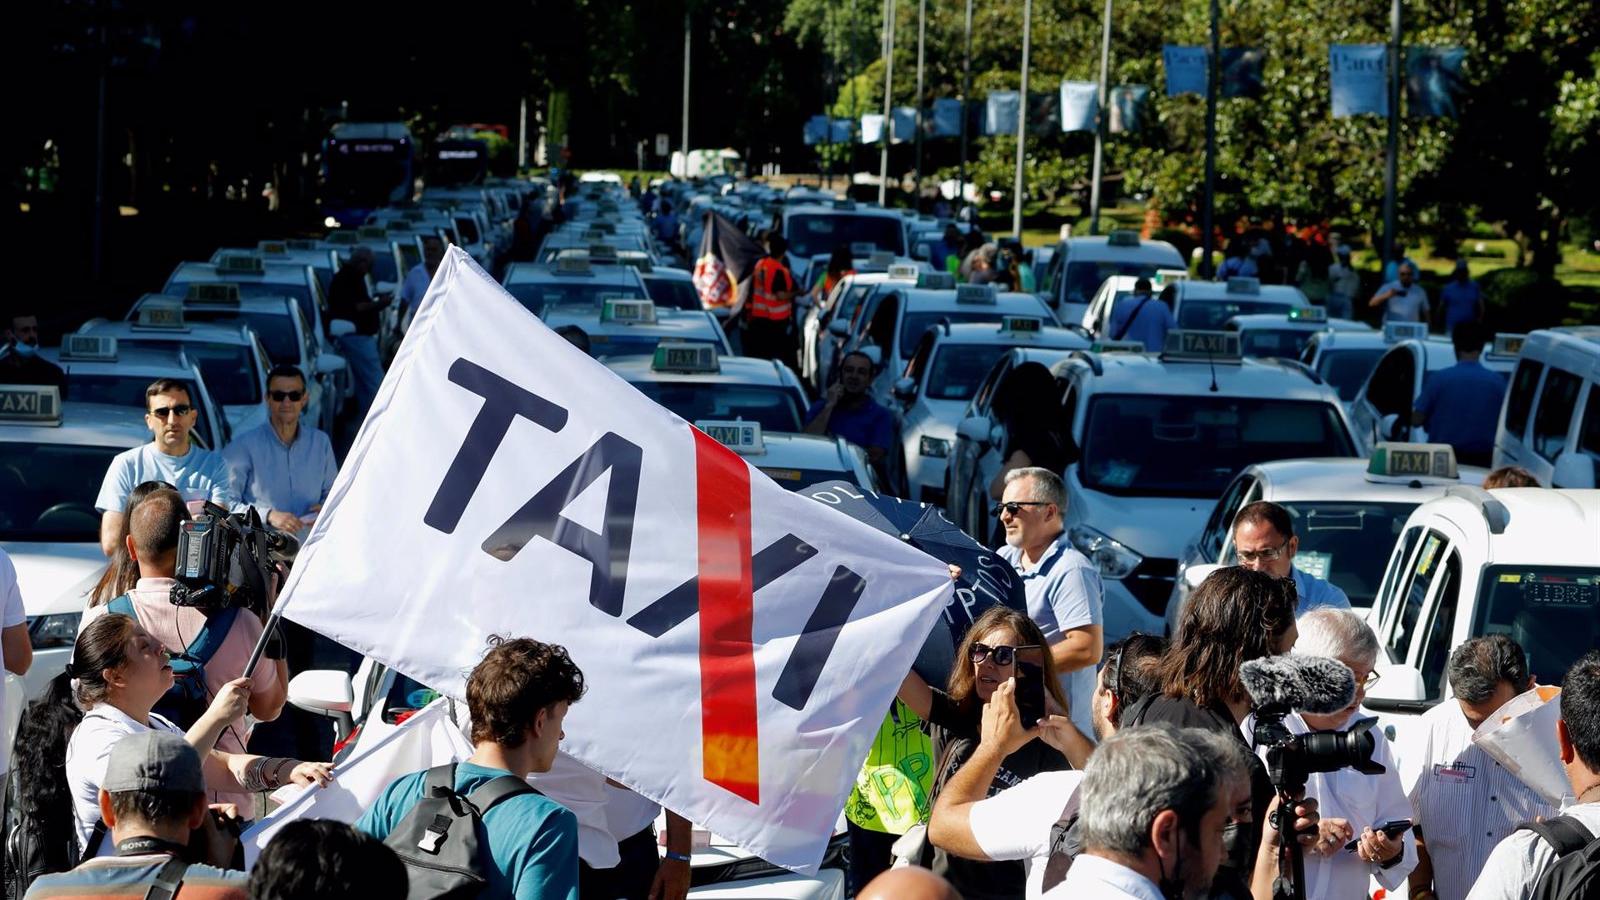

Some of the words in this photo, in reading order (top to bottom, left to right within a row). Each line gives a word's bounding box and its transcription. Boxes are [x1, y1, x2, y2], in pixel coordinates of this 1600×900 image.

[1185, 335, 1224, 352] TAXI
[670, 350, 697, 366] TAXI
[1392, 453, 1429, 474] TAXI
[424, 357, 868, 712] TAXI
[1531, 583, 1592, 603] LIBRE
[121, 840, 150, 851] SONY
